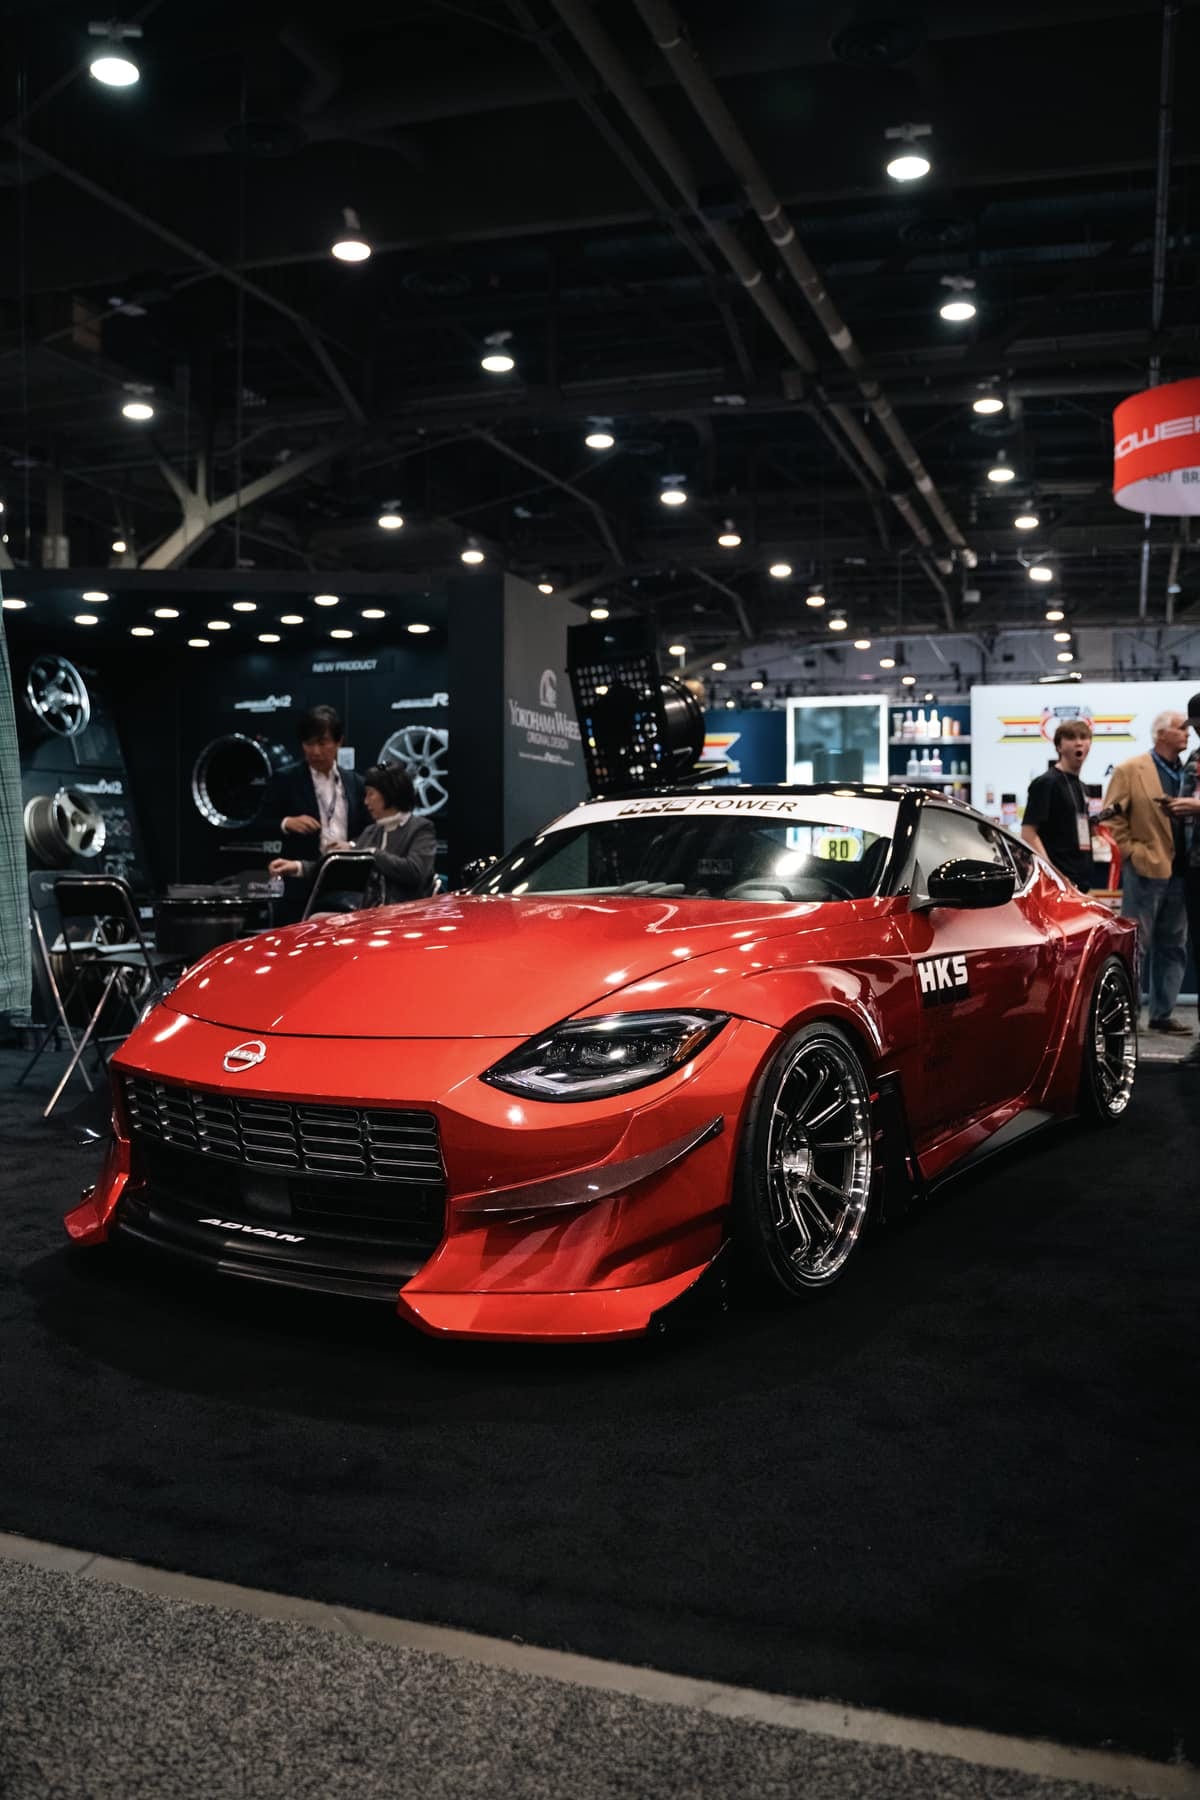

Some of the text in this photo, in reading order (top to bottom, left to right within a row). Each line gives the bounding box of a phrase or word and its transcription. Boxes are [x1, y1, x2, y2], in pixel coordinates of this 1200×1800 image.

[335, 659, 377, 671] PRODUCT
[696, 799, 798, 813] POWER
[917, 955, 968, 993] HKS
[198, 1218, 305, 1242] ADVAN
